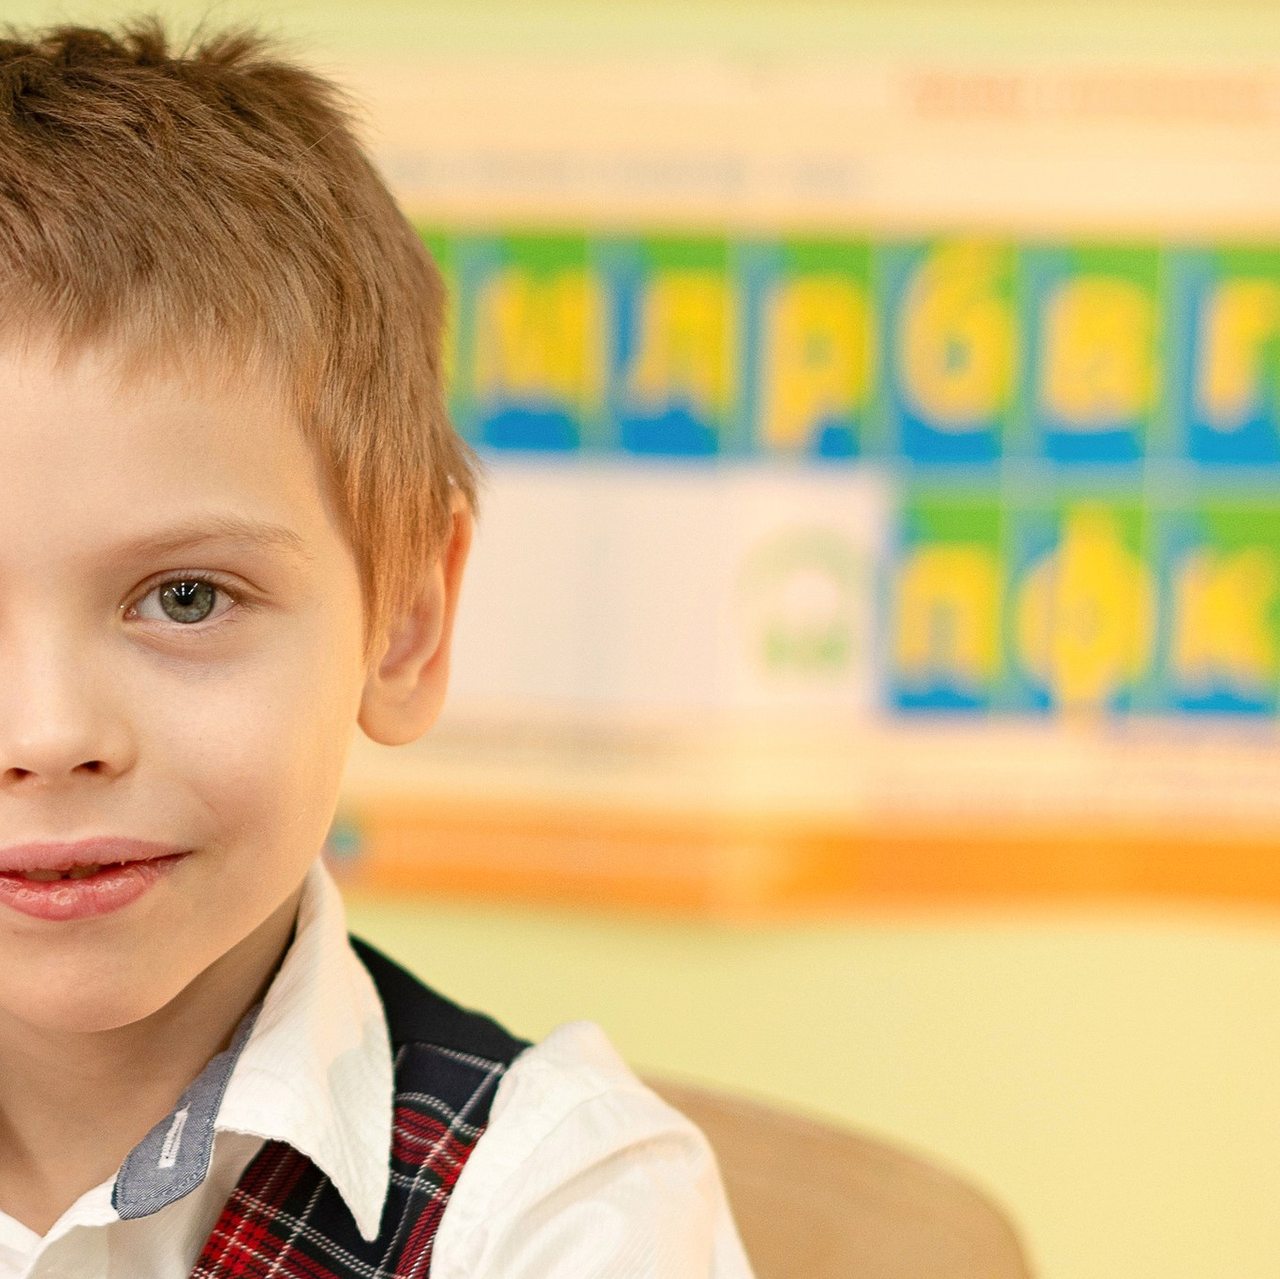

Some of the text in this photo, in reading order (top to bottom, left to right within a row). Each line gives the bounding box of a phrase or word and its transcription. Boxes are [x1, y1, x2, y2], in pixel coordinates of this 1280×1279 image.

[756, 270, 872, 457] р
[897, 232, 1016, 433] б
[892, 541, 1005, 685] п
[1014, 498, 1155, 734] ф
